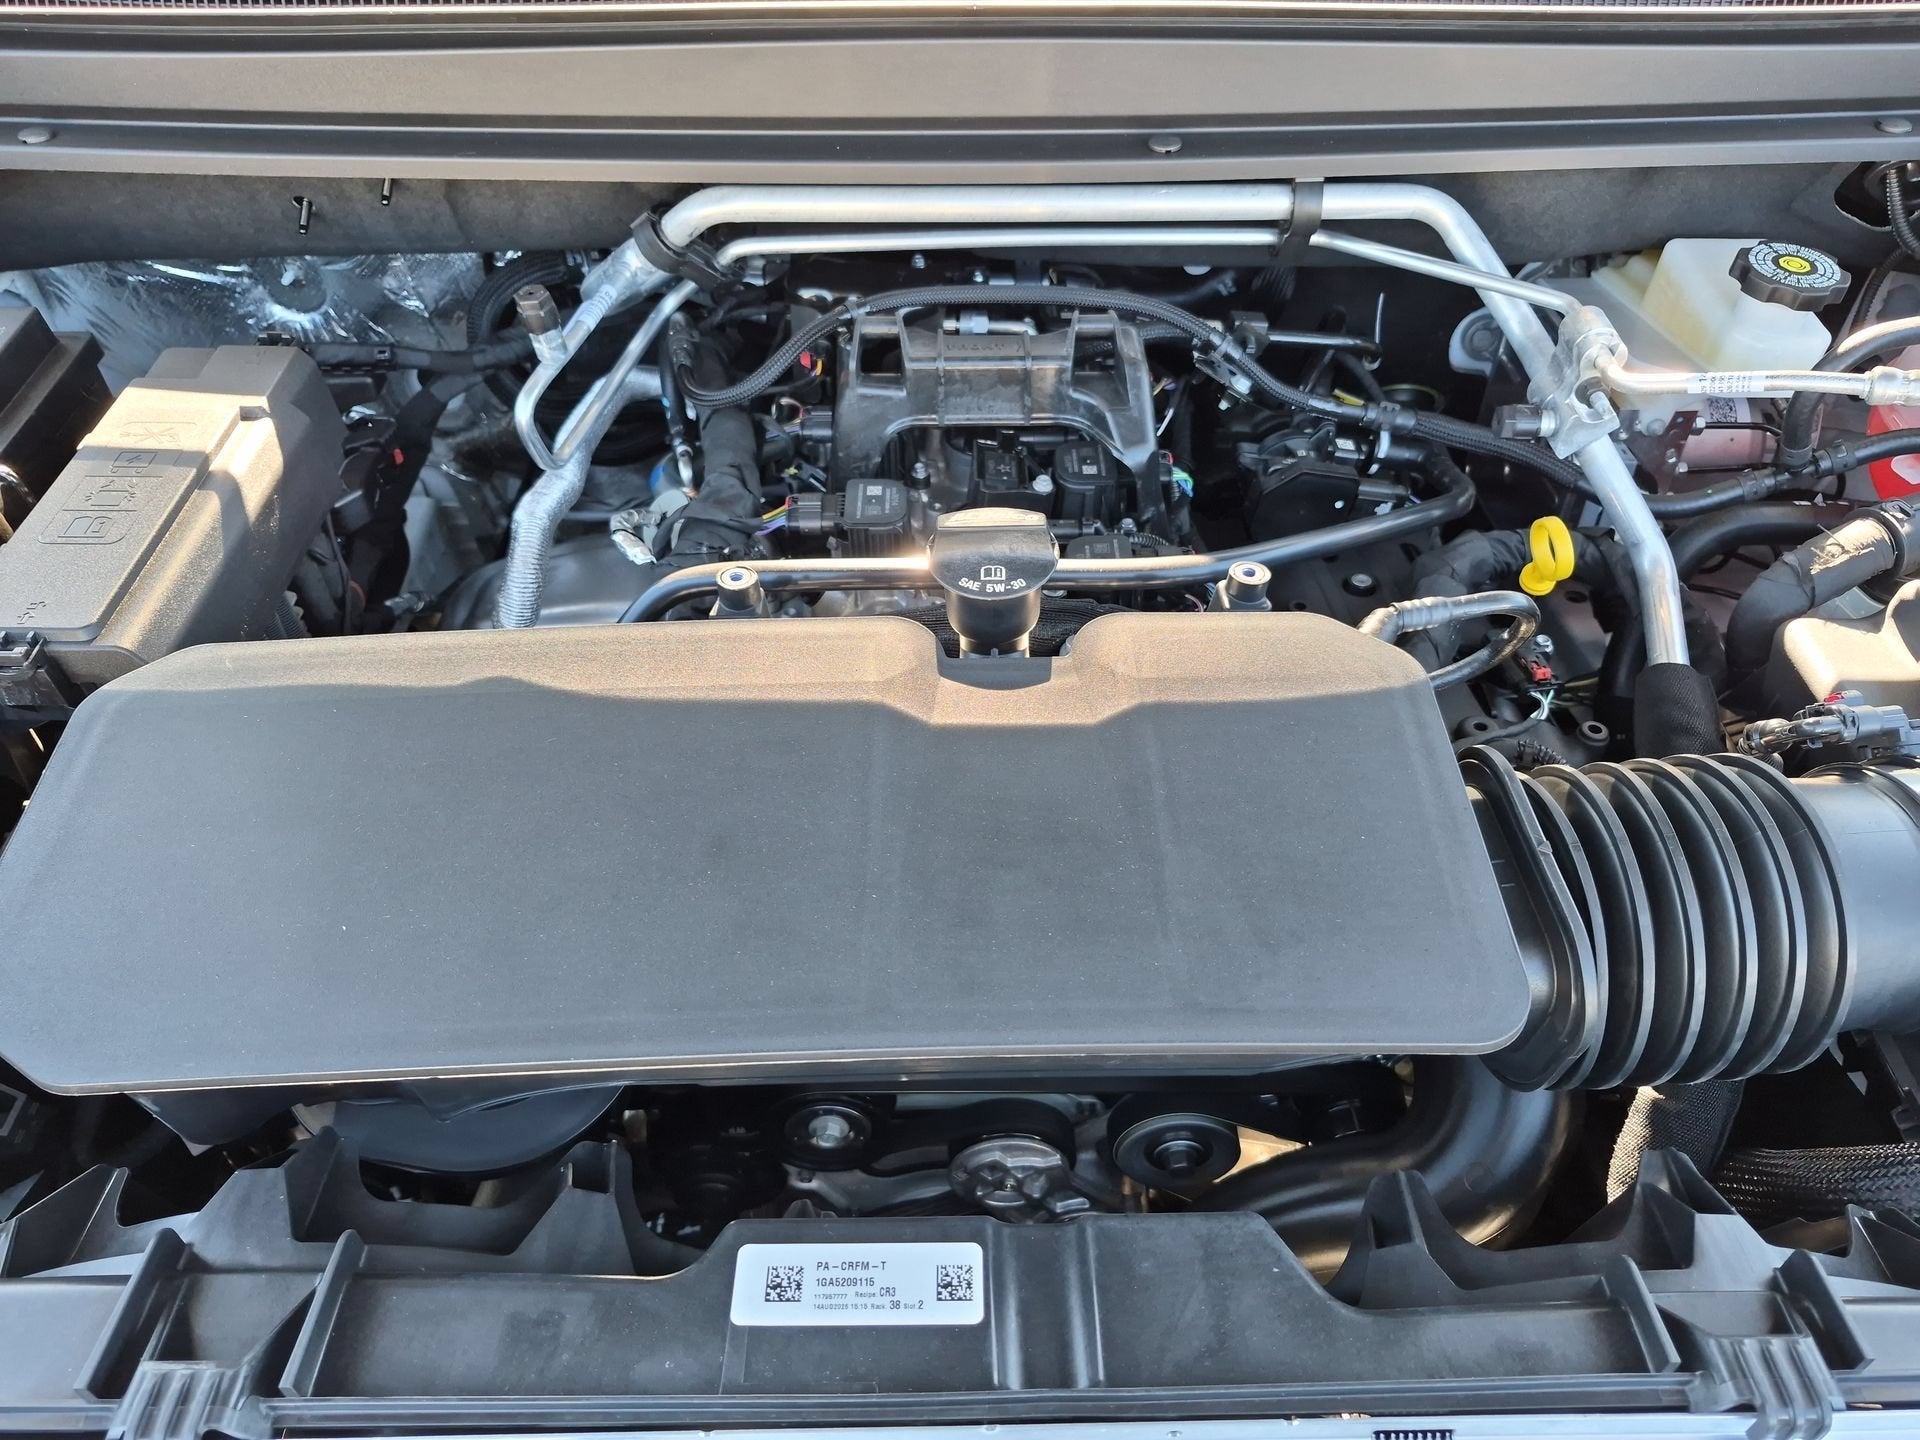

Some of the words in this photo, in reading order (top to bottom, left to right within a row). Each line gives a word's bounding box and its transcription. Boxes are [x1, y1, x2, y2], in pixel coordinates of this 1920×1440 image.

[958, 577, 981, 591] SAE
[985, 578, 1027, 592] 5W-30
[879, 1286, 896, 1297] CR3
[889, 1300, 901, 1310] 38
[918, 1300, 924, 1310] 2
